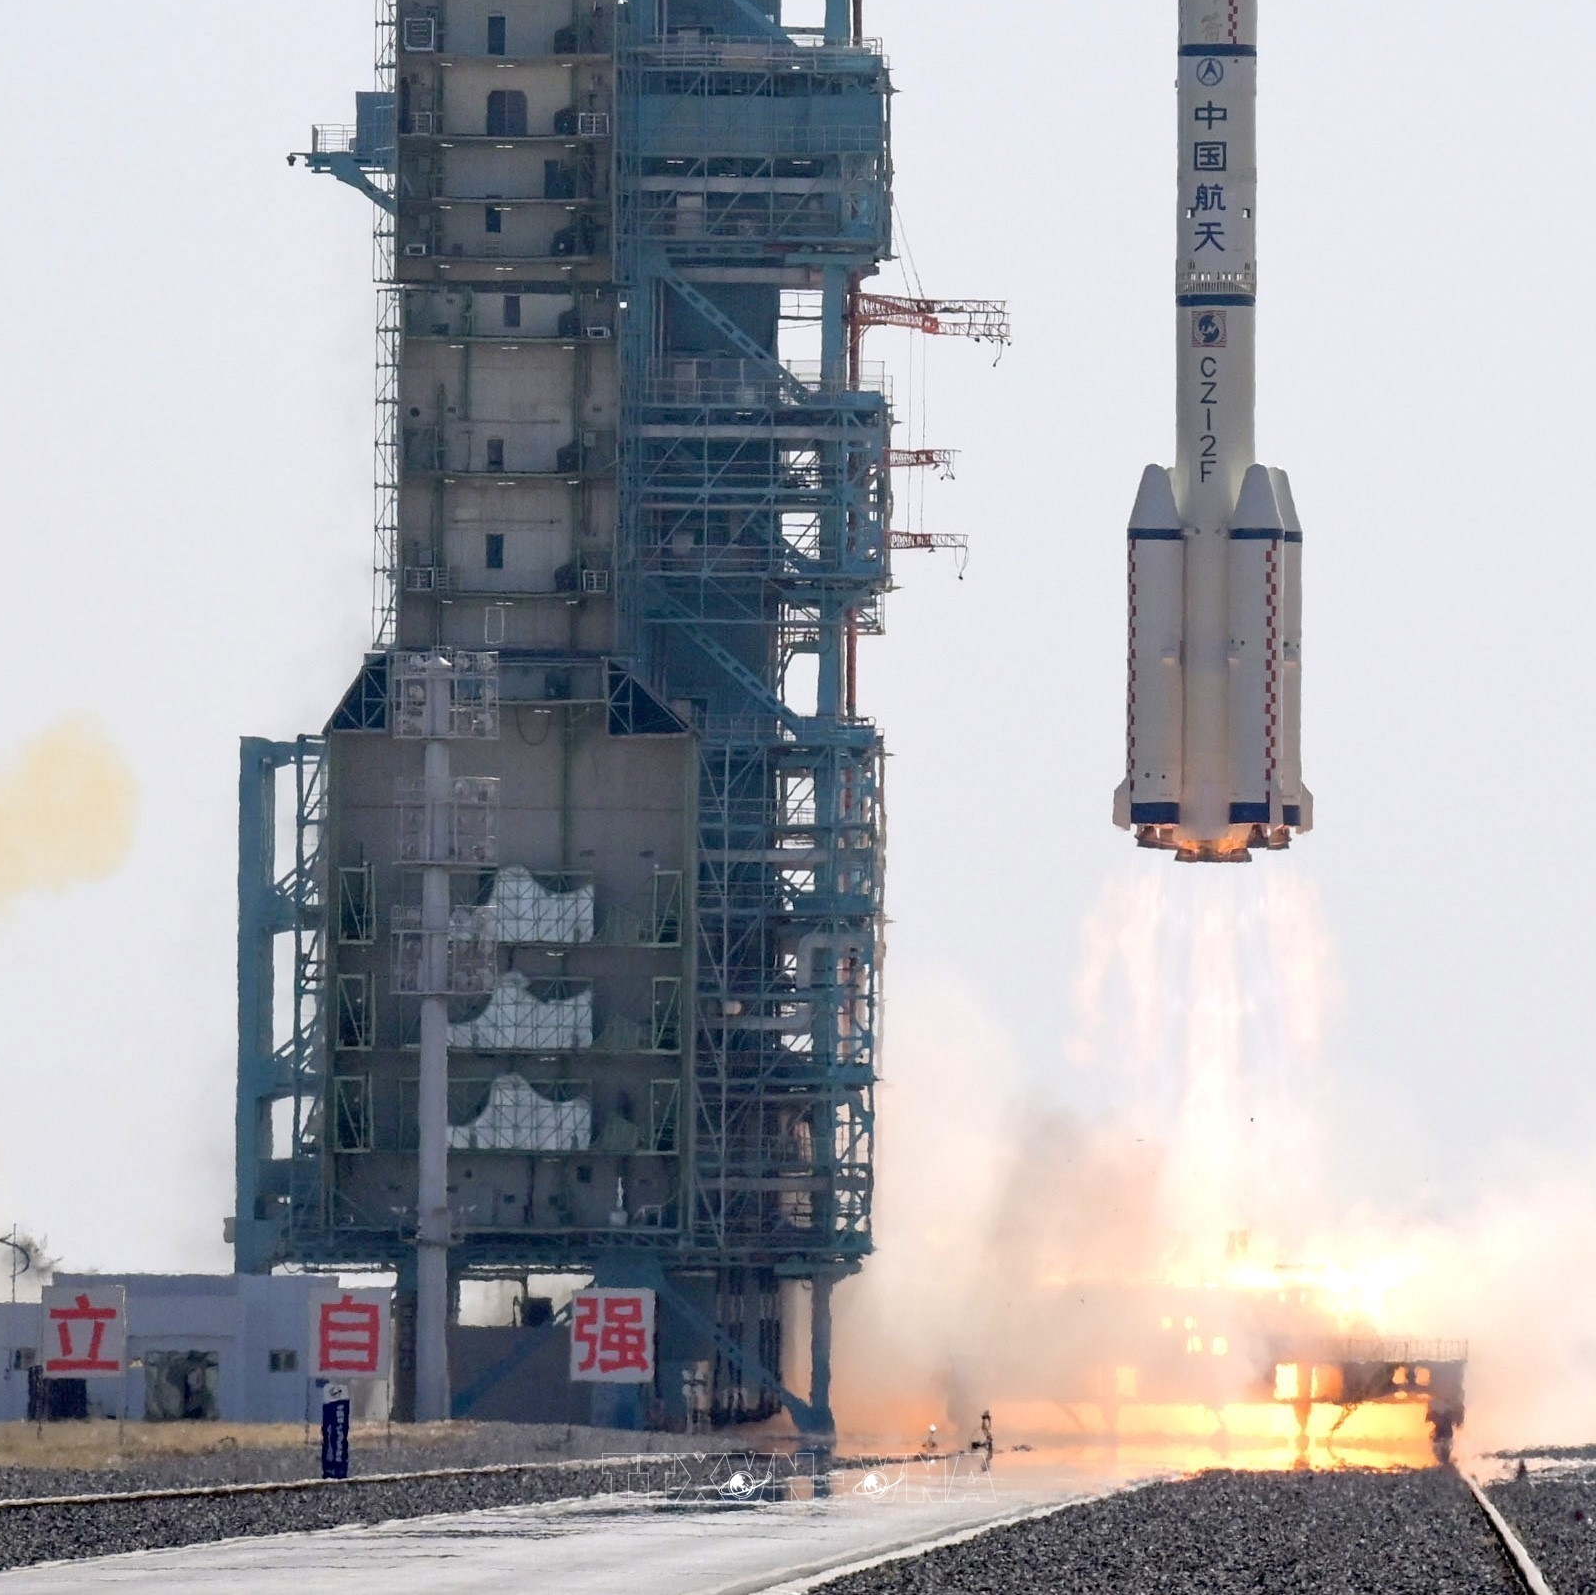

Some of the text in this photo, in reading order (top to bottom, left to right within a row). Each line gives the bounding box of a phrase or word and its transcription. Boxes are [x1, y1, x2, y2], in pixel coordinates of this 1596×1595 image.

[1194, 100, 1228, 253] 中国航天
[47, 1296, 120, 1372] 立
[319, 1295, 380, 1372] 自
[575, 1297, 649, 1372] 强
